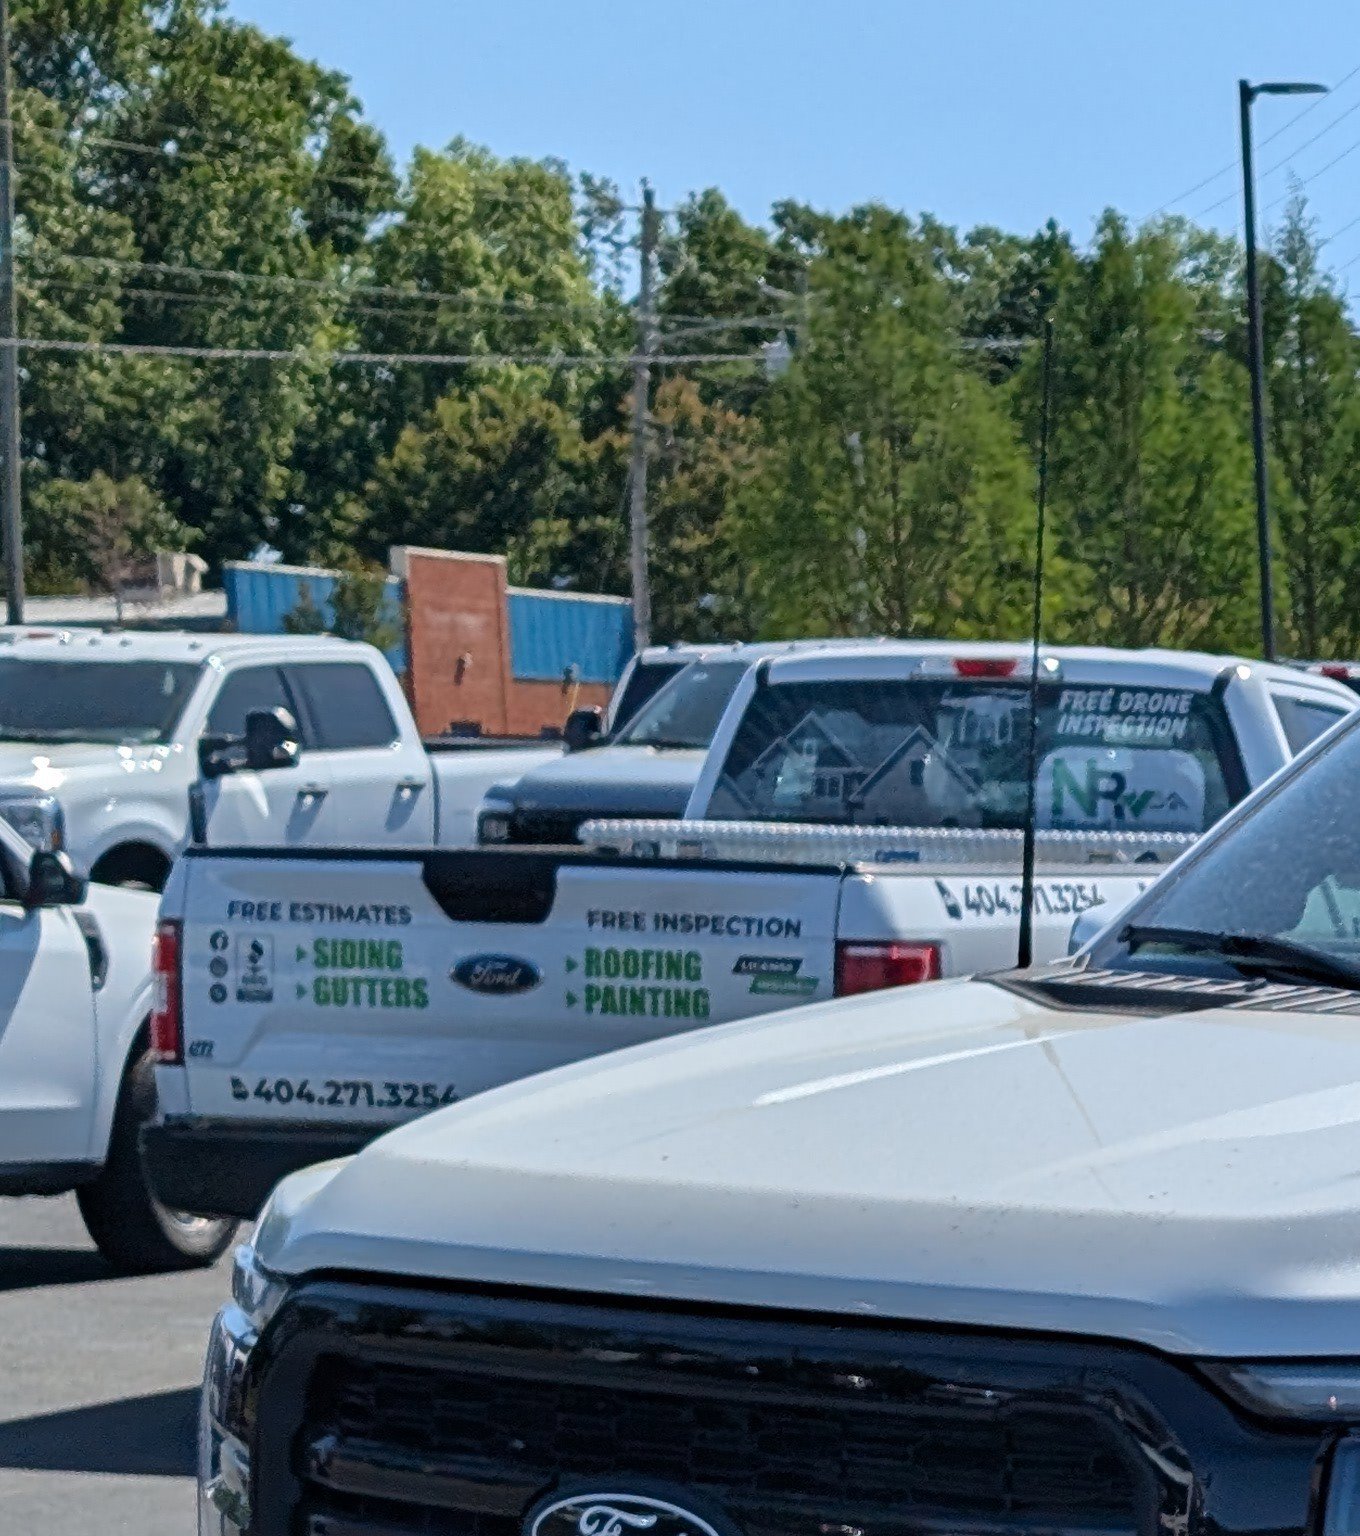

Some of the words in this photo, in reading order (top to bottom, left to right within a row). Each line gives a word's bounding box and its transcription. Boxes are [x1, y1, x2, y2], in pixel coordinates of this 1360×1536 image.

[1058, 689, 1116, 712] FREE
[1118, 691, 1194, 713] DRONE
[1056, 713, 1189, 738] INSPECTION
[226, 900, 282, 922] FREE
[289, 902, 413, 925] ESTIMATES
[586, 909, 647, 932] FREE
[653, 912, 802, 938] INSPECTION
[312, 938, 403, 970] SIDING
[584, 947, 703, 982] ROOFING
[312, 975, 429, 1009] GUTTERS
[584, 984, 711, 1018] PAINTING
[252, 1076, 461, 1108] 404.271.3254
